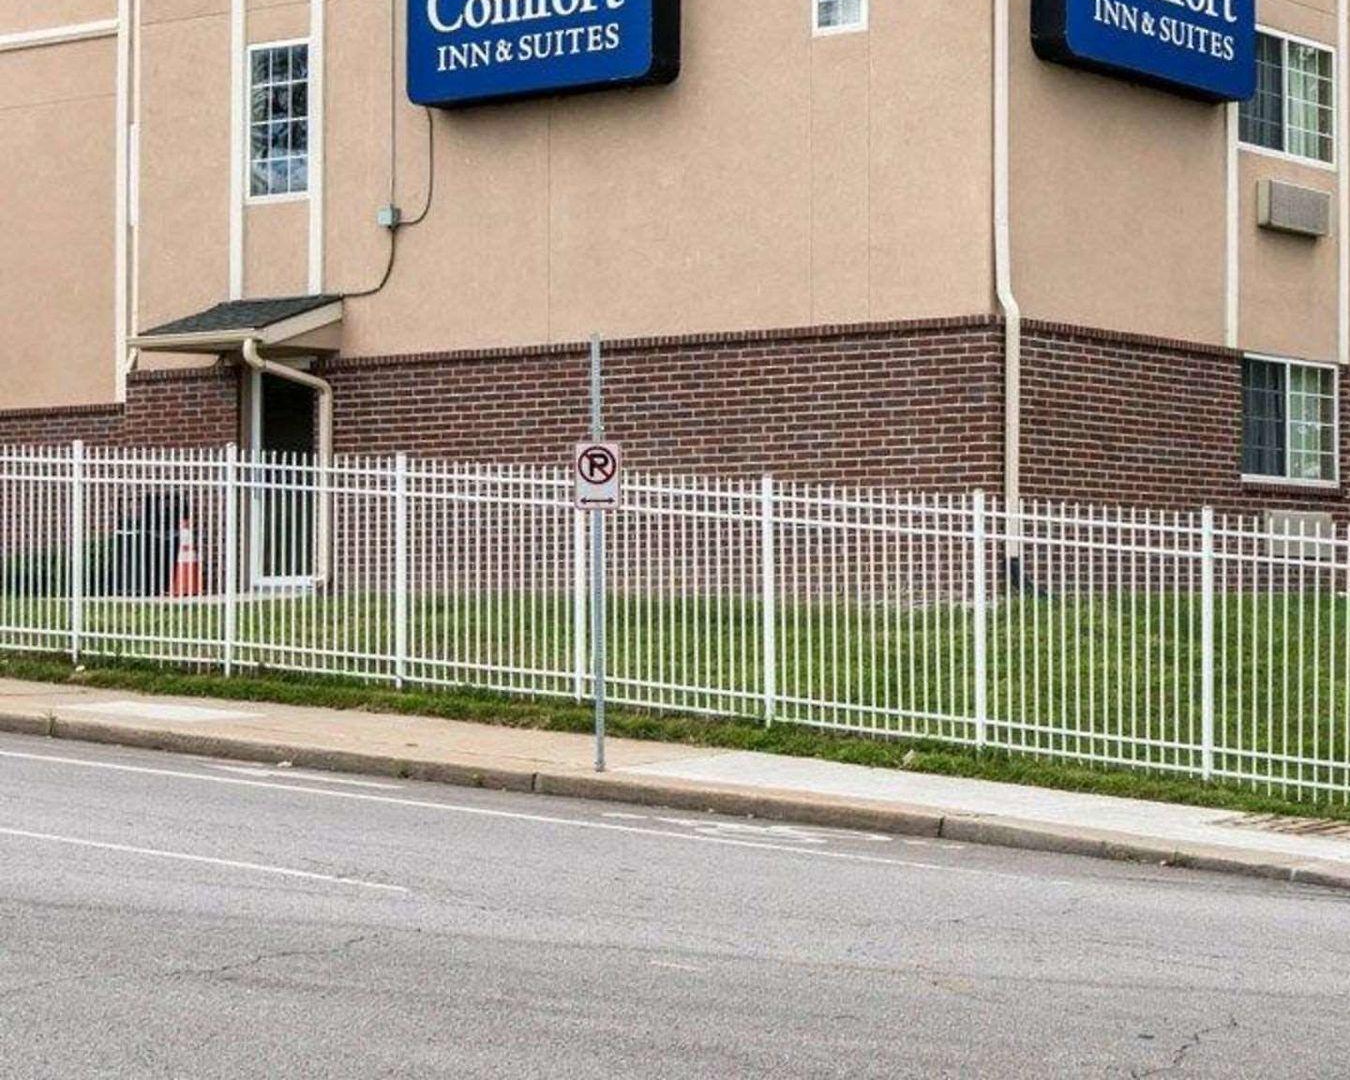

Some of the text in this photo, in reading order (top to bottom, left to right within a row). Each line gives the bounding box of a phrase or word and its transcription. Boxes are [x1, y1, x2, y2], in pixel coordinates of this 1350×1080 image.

[437, 23, 620, 71] INN & SUITES
[1141, 11, 1155, 37] &
[1159, 15, 1235, 61] SUITES
[589, 453, 609, 477] P
